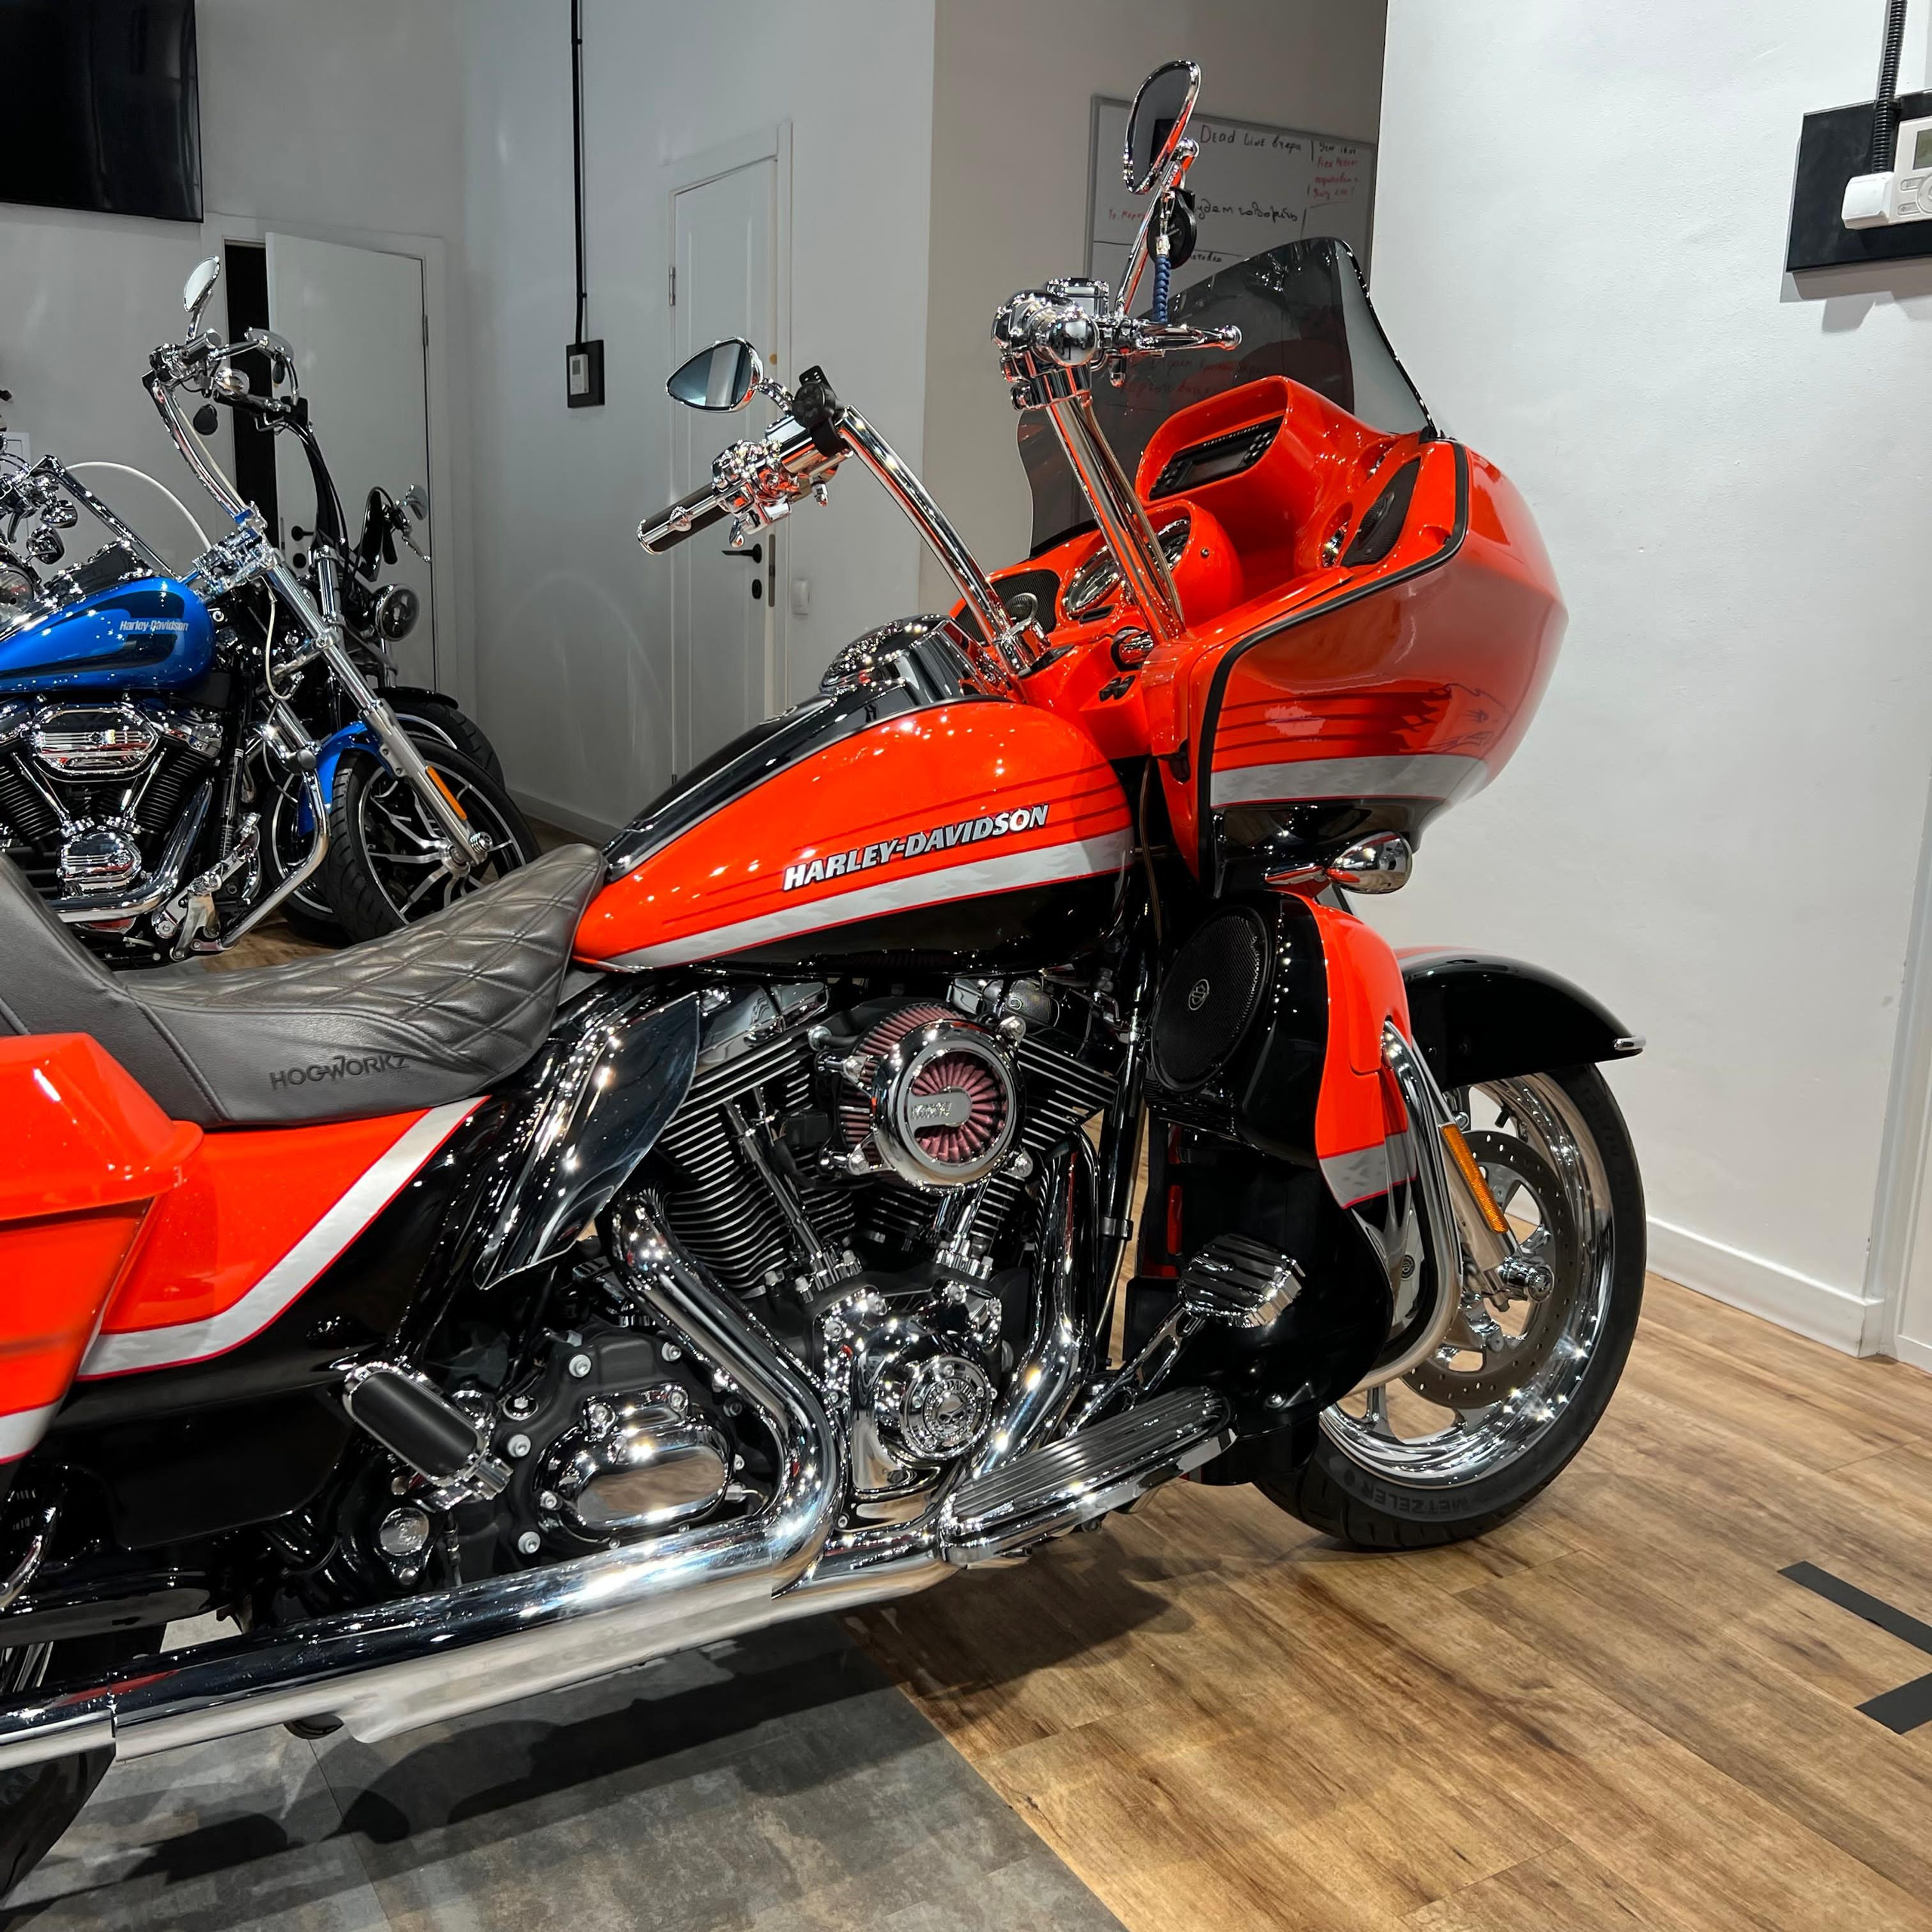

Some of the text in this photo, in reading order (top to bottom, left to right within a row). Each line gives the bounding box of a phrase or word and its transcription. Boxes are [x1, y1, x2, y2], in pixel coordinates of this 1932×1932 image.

[119, 620, 189, 632] Harley-Davidson
[782, 804, 1050, 892] HARLEY-DAVIDSON
[269, 1054, 411, 1091] HOGWORKZ
[1360, 1481, 1471, 1515] METZELER
